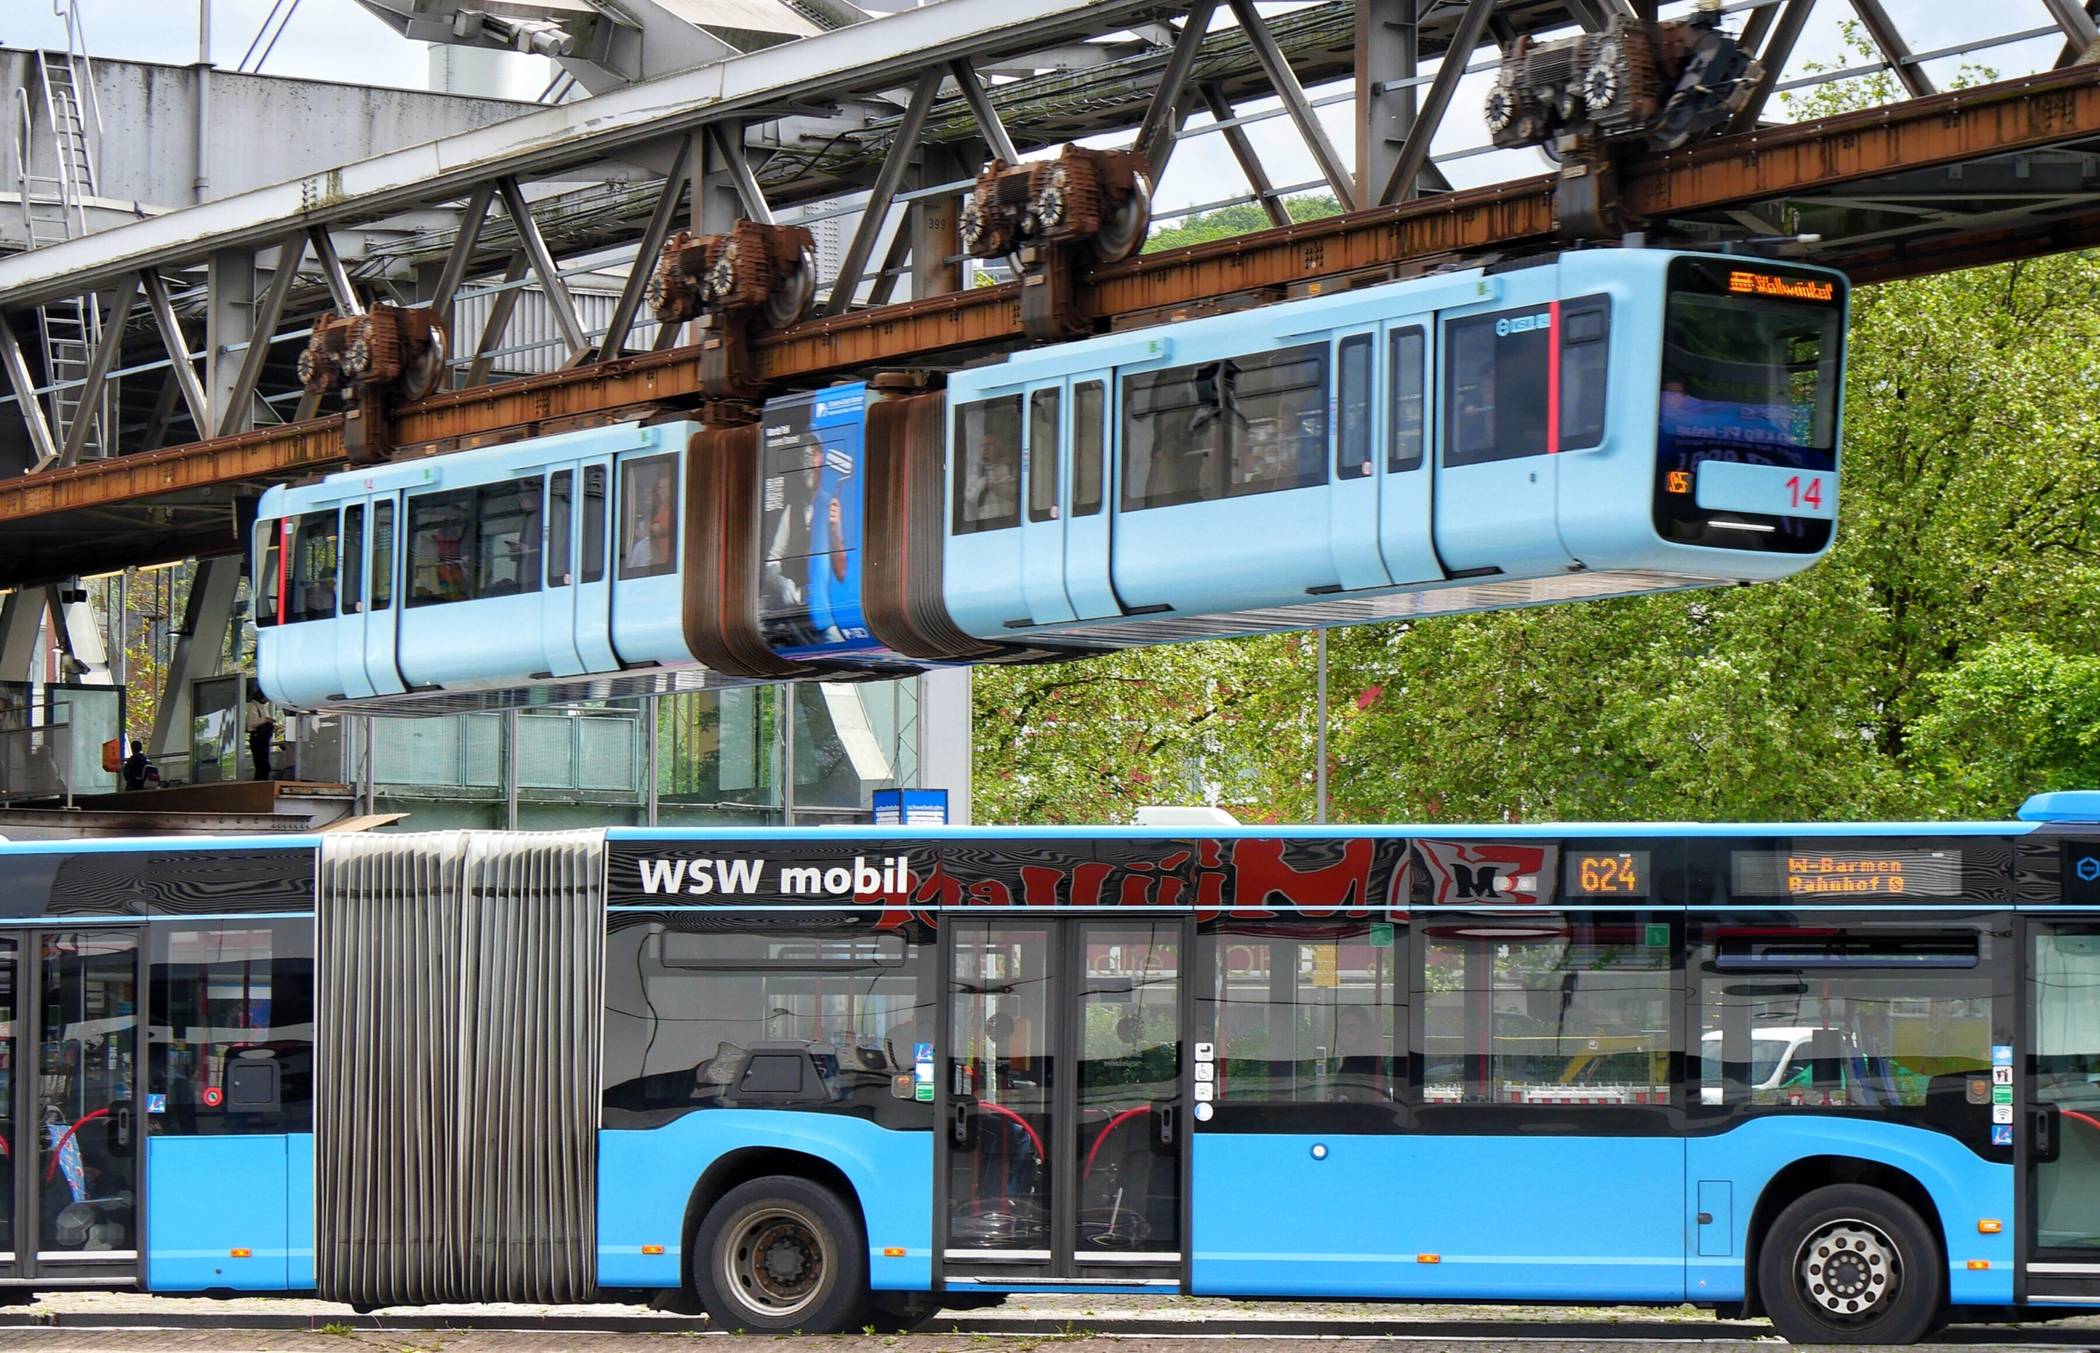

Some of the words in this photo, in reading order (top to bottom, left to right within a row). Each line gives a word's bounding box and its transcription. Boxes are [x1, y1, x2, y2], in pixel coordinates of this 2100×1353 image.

[1785, 475, 1822, 510] 14
[638, 859, 764, 894] WSW
[780, 856, 908, 895] mobil
[1581, 857, 1636, 891] 624
[1788, 857, 1903, 873] W-Barmen
[1788, 876, 1880, 891] Bahnhof
